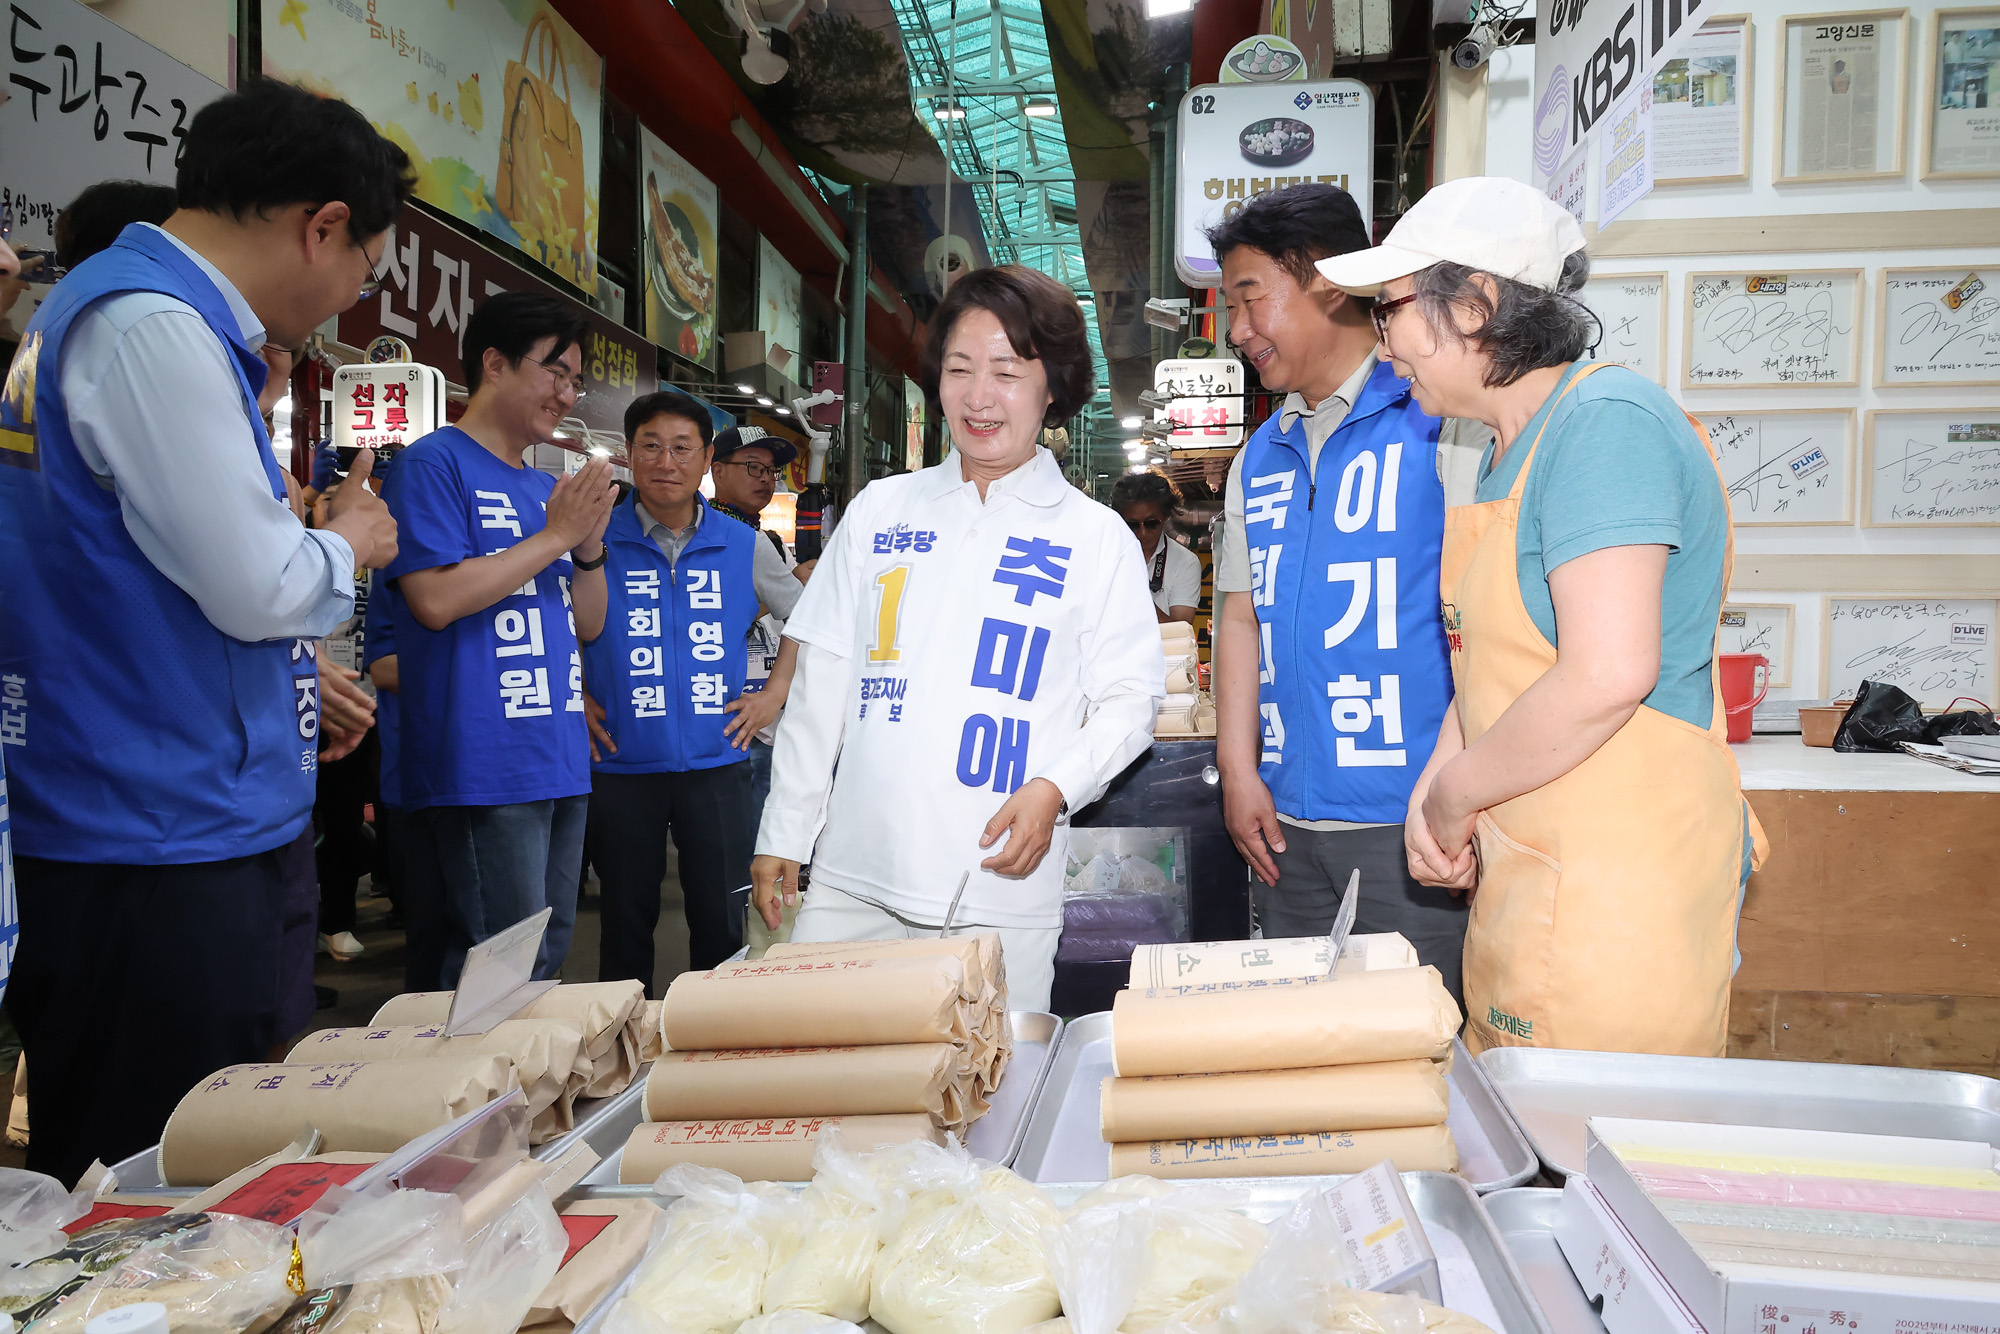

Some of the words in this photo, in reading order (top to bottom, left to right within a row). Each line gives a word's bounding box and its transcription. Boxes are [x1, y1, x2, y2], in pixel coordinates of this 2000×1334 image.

[1815, 24, 1874, 41] 고양신문
[1572, 2, 1636, 146] KBS
[1191, 95, 1215, 114] 82
[1314, 92, 1360, 104] 일산전통시장
[408, 370, 419, 381] 51
[584, 331, 639, 396] 성잡화
[1226, 365, 1235, 374] 81
[1168, 407, 1230, 436] 반찬
[873, 530, 938, 554] 민주당
[475, 488, 552, 719] 국의원
[867, 563, 912, 666] 1
[1323, 440, 1408, 768] 이기헌
[624, 568, 667, 719] 국회의원
[686, 568, 728, 716] 김영환
[956, 535, 1073, 795] 추미애
[1487, 1005, 1533, 1040] 대한제분
[684, 1117, 825, 1141] 부여옛날국수
[1829, 1309, 1847, 1327] 秀
[1895, 1319, 1949, 1332] 2002년부터
[1950, 1324, 1989, 1334] 시작해서
